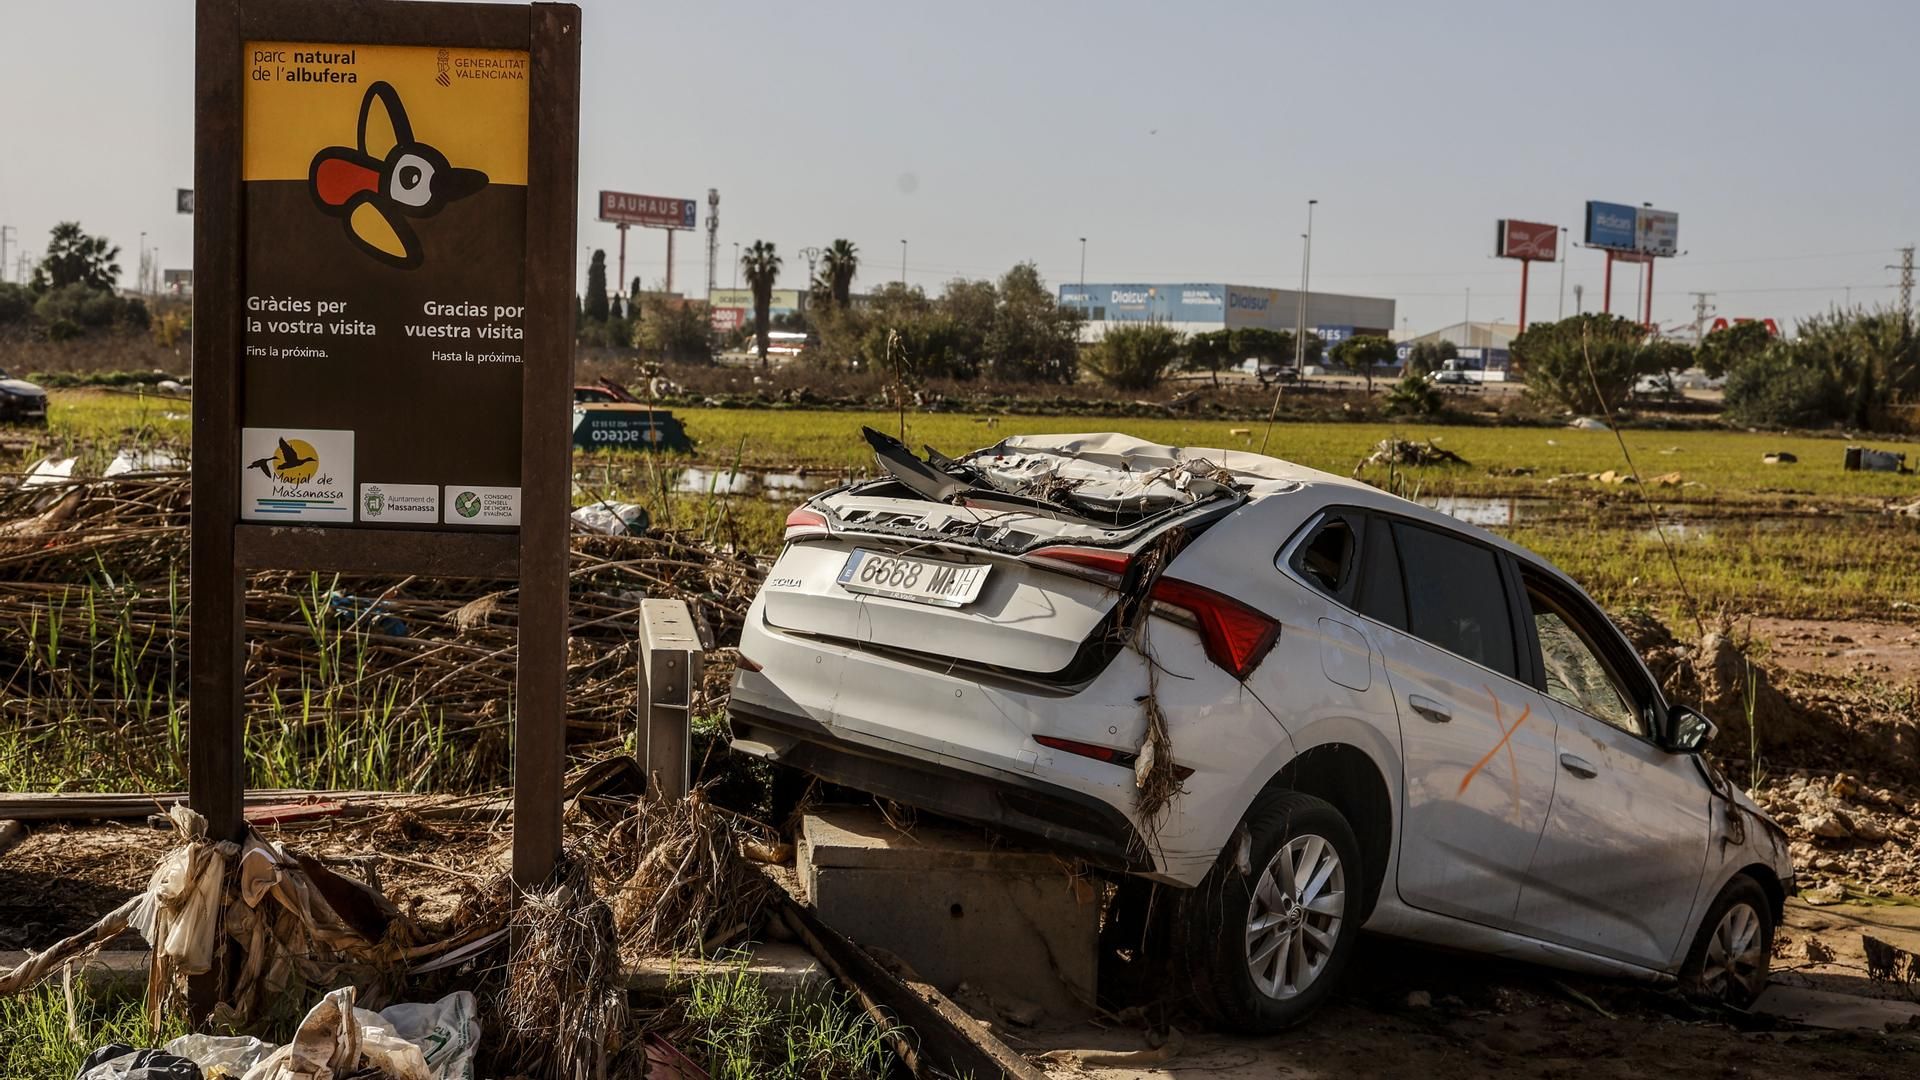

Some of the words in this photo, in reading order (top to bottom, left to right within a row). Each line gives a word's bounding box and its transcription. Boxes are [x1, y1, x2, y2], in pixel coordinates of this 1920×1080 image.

[254, 50, 286, 65] parc
[294, 50, 356, 65] natural
[454, 58, 526, 69] GENERALITAT
[252, 65, 271, 81] de
[276, 66, 357, 83] l'albufera
[456, 69, 524, 80] VALENCIANA
[607, 194, 680, 216] BAUHAUS
[246, 296, 312, 312] Gràcies
[317, 301, 347, 317] per
[423, 300, 488, 317] Gracias
[494, 305, 525, 321] por
[247, 316, 262, 333] la
[268, 320, 323, 335] vostra
[329, 320, 377, 336] visita
[404, 323, 471, 338] vuestra
[476, 323, 524, 340] visita
[246, 345, 267, 356] Fins
[269, 346, 279, 357] la
[281, 346, 329, 359] próxima.
[432, 351, 462, 361] Hasta
[465, 351, 475, 361] la
[477, 352, 524, 364] próxima.
[592, 430, 639, 442] acteco
[272, 471, 311, 490] Marjal
[317, 471, 333, 485] de
[272, 485, 344, 499] Massanassa
[387, 495, 425, 503] Ajuntament
[387, 503, 435, 512] Massanassa
[860, 556, 923, 589] 6668
